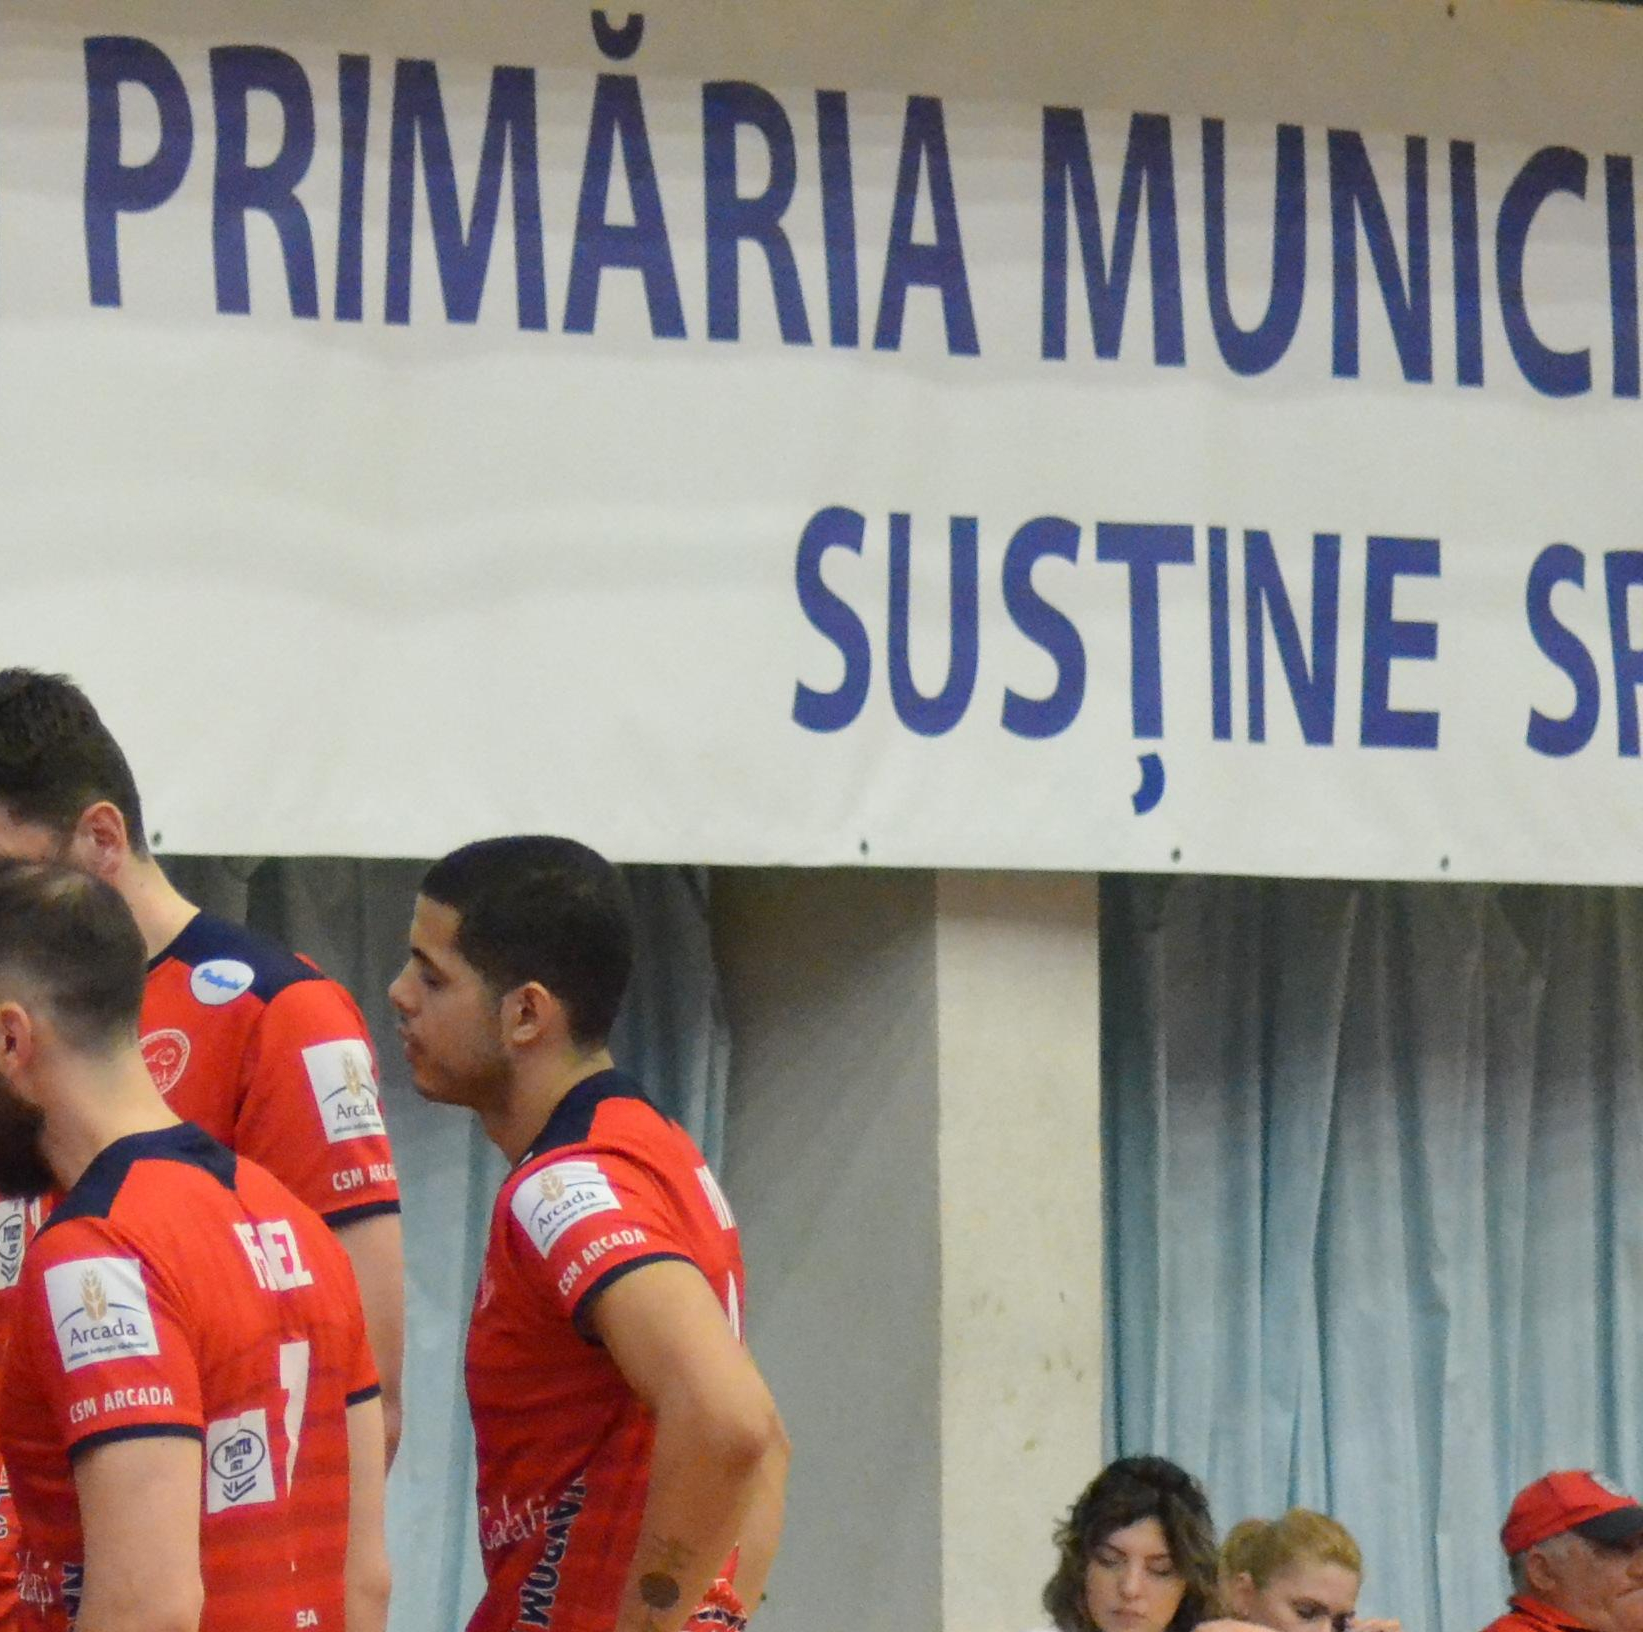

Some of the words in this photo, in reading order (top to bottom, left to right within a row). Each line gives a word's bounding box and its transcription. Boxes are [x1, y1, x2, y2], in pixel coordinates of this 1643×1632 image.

[81, 10, 983, 358] PRIMĂRIA
[790, 504, 1442, 817] SUSȚINE
[331, 1169, 365, 1192] CSM
[581, 1227, 648, 1266] ARCADA
[69, 1316, 139, 1347] Arcada
[70, 1396, 98, 1424] CSM
[104, 1385, 175, 1413] ARCADA
